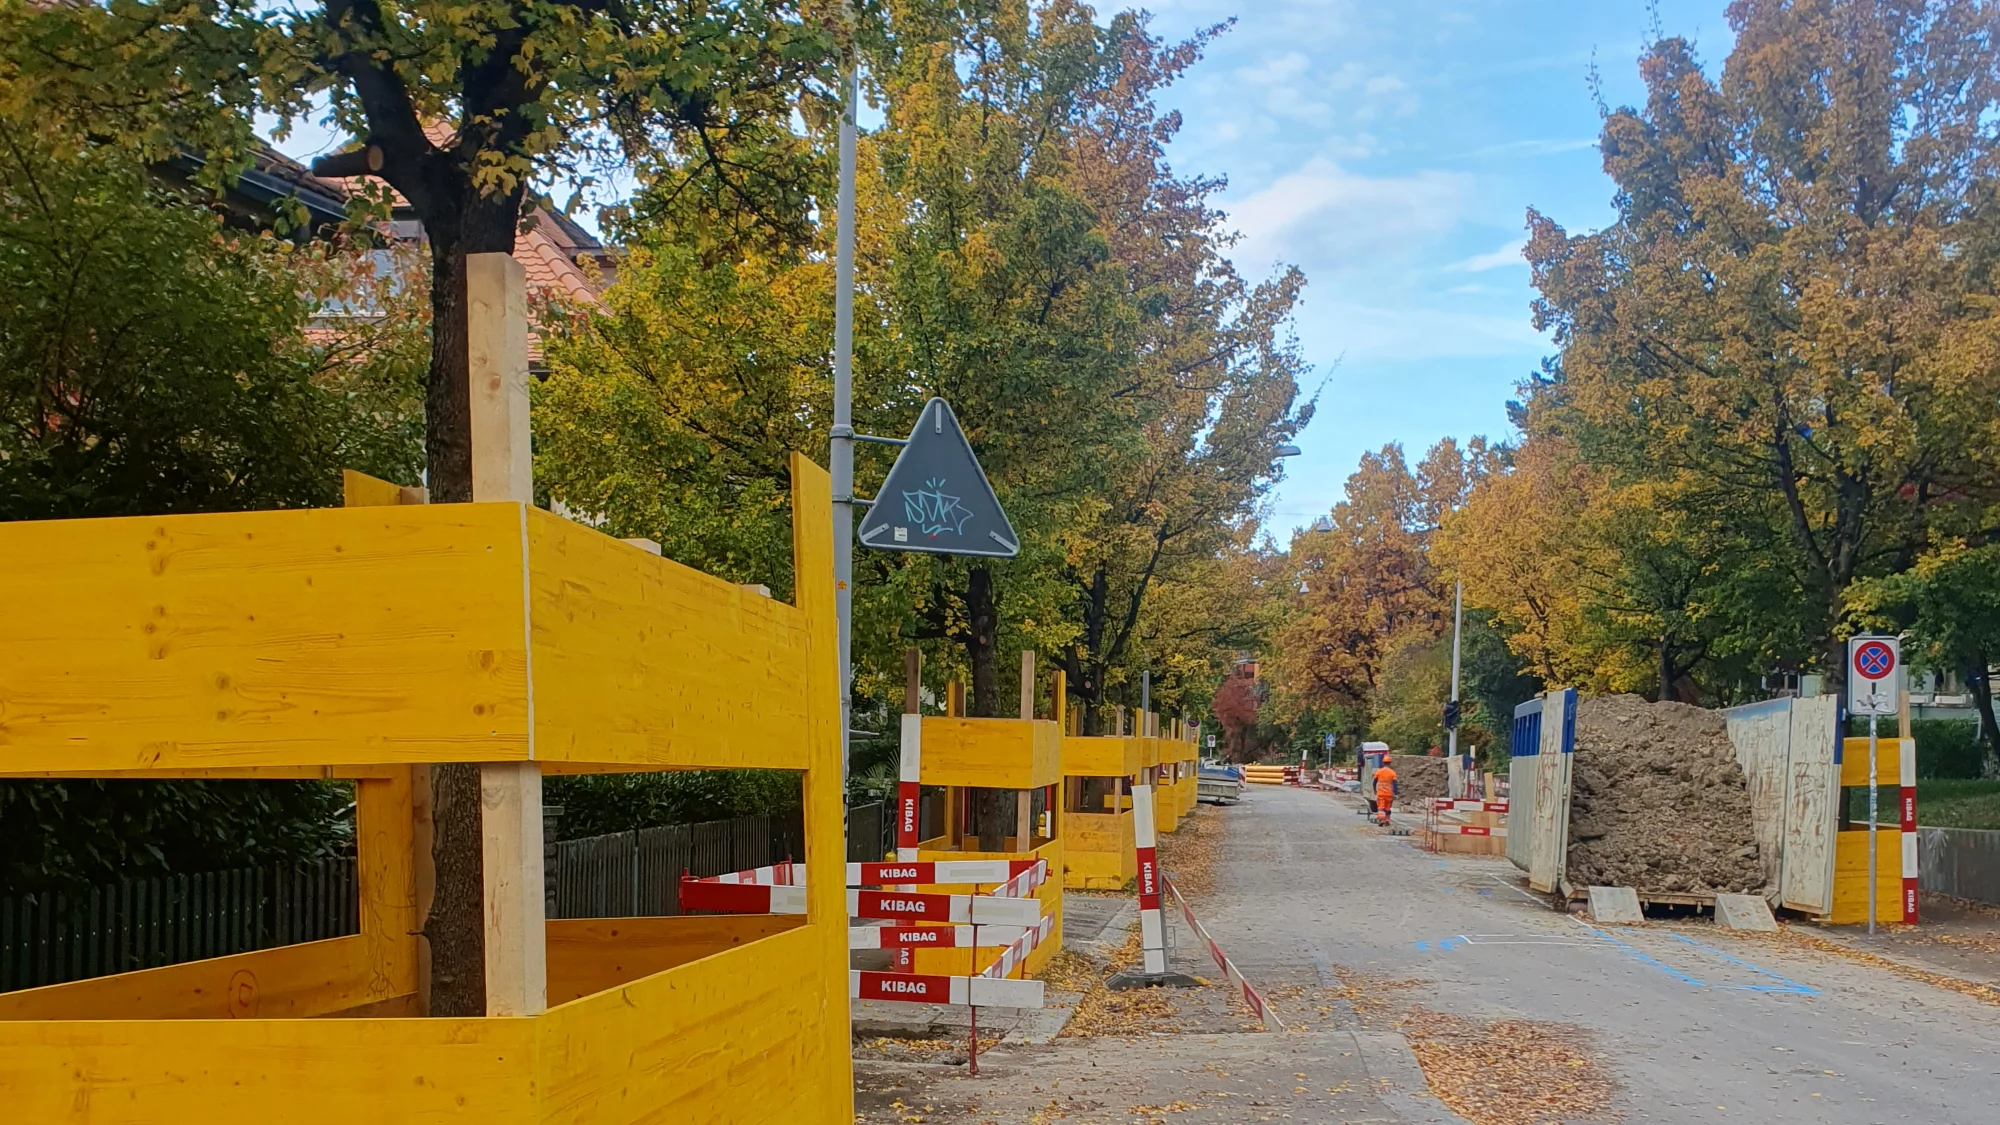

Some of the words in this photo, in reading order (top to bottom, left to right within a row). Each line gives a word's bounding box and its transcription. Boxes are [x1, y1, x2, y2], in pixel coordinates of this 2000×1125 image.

[904, 798, 914, 832] KIBAG
[880, 868, 917, 878] KIBAG
[1143, 862, 1153, 894] KIBAG
[880, 899, 926, 913] KIBAG
[899, 932, 937, 942] KIBAG
[881, 980, 927, 994] KIBAG
